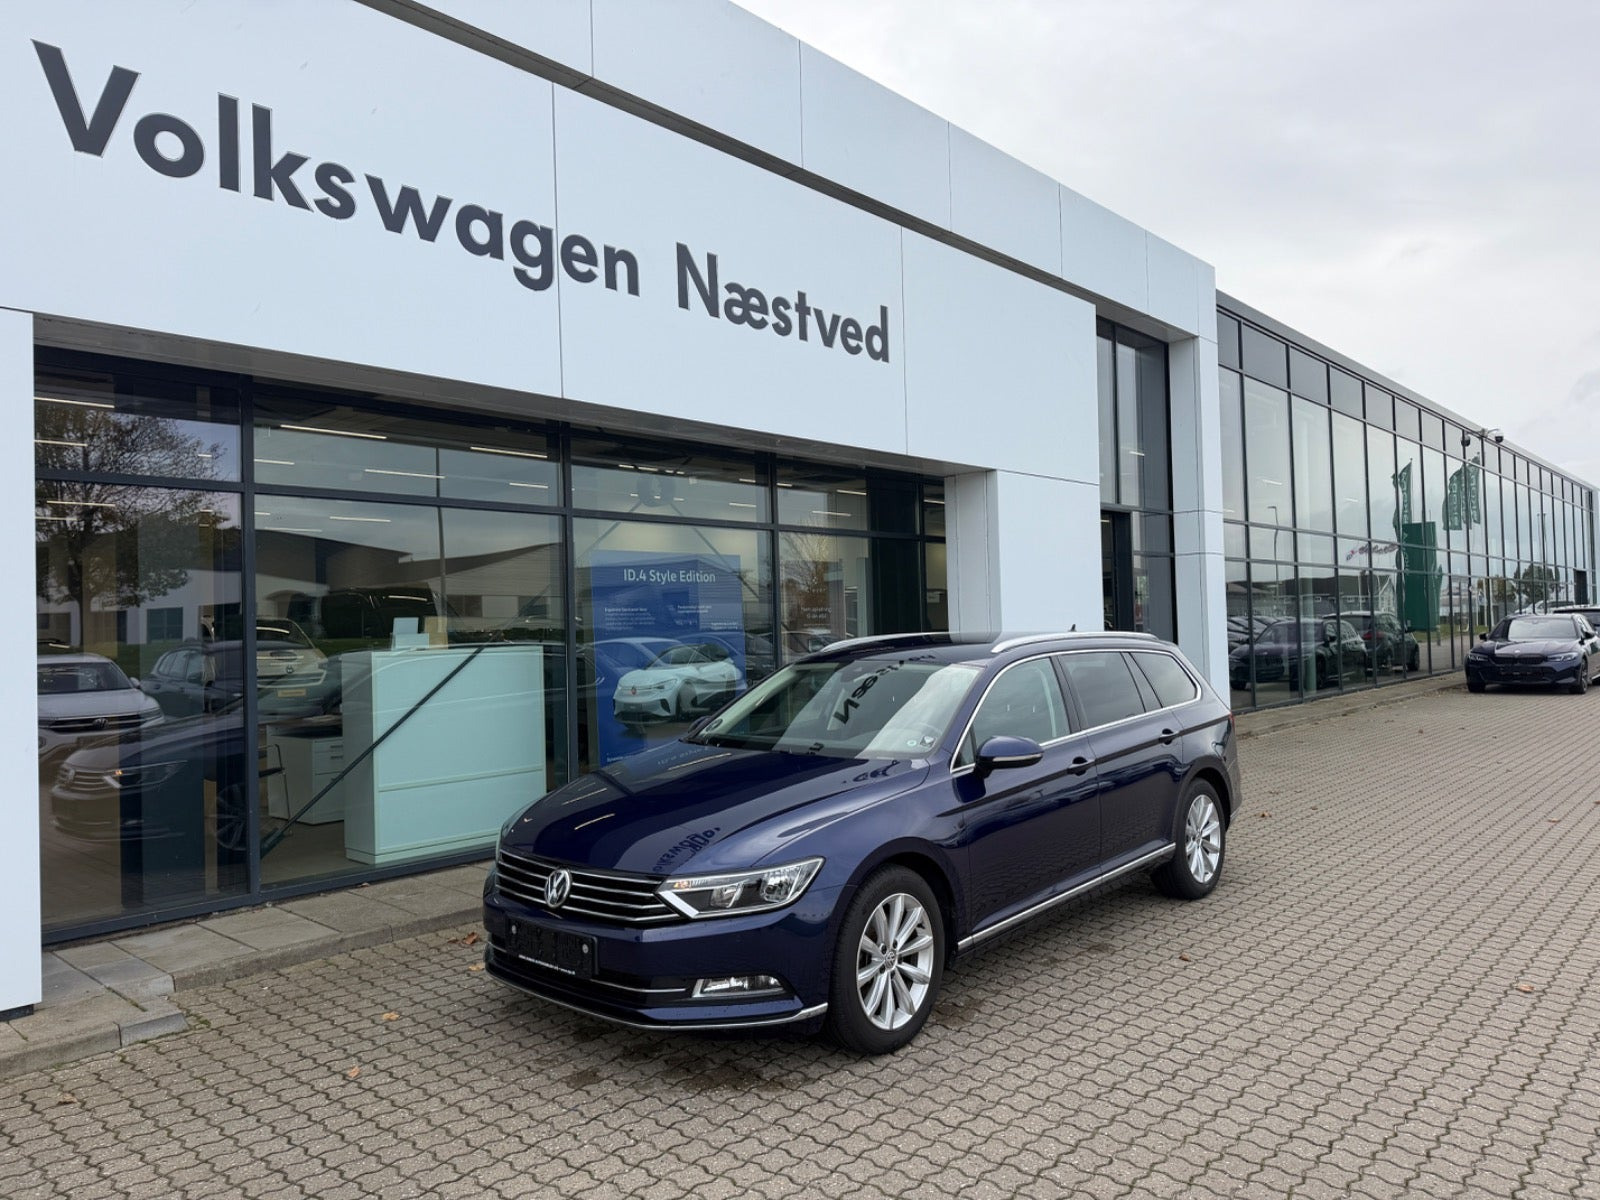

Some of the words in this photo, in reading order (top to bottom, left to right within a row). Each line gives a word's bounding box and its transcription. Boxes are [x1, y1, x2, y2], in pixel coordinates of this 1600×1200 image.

[31, 40, 640, 297] Volkswagen
[676, 242, 890, 364] Næstved
[623, 568, 647, 582] ID.4
[649, 569, 677, 585] Style
[679, 570, 716, 583] Edition
